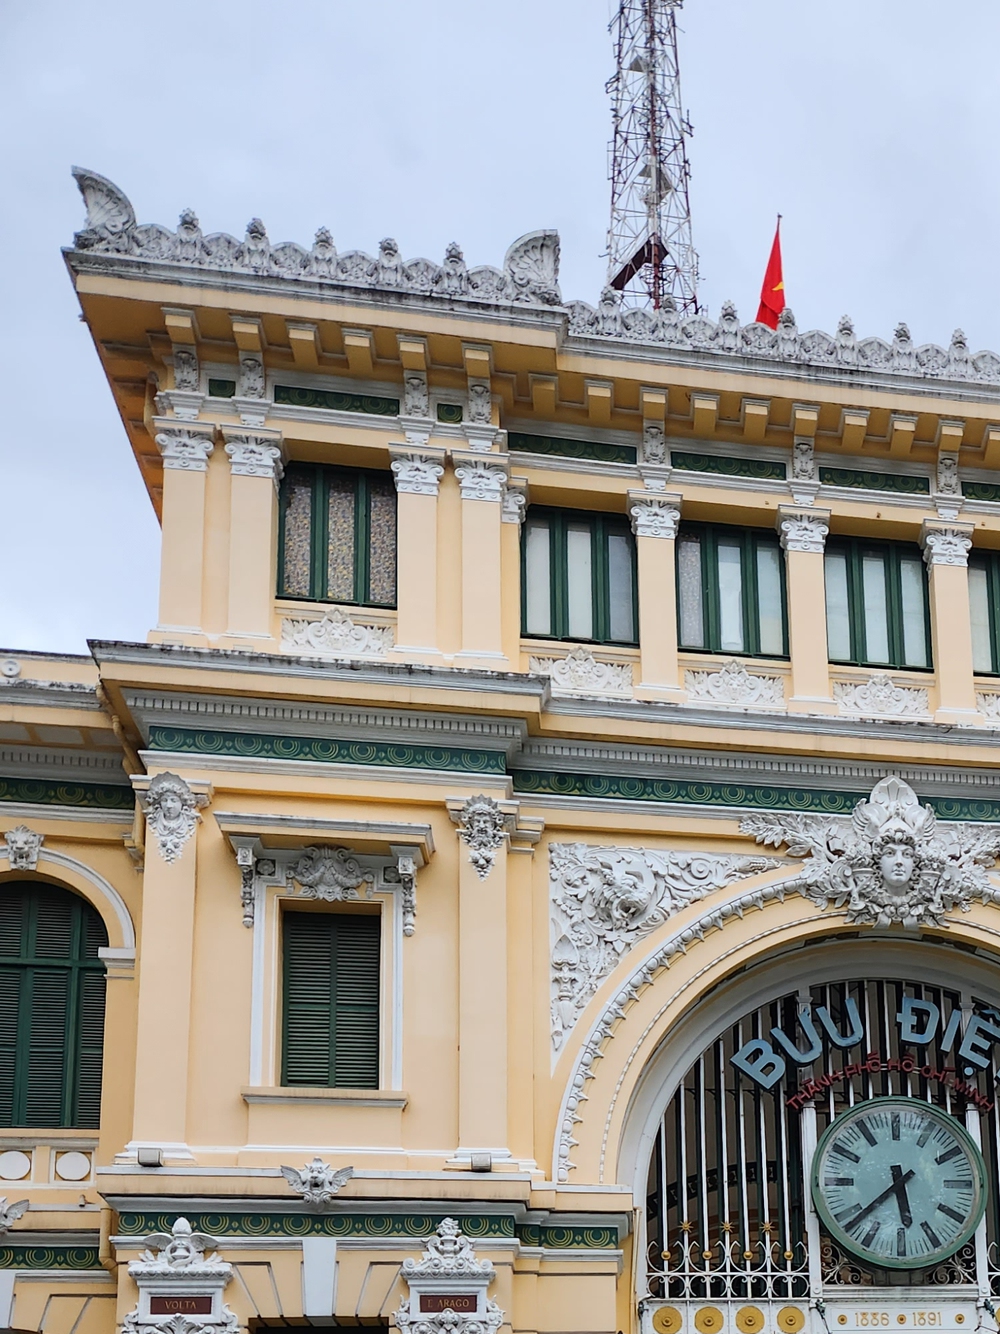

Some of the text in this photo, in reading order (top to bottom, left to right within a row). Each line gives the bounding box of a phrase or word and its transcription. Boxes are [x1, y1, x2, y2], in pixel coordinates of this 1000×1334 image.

[165, 1300, 197, 1310] VOLTA
[437, 1298, 470, 1308] ARAGO
[855, 1311, 942, 1327] 1886 1891
